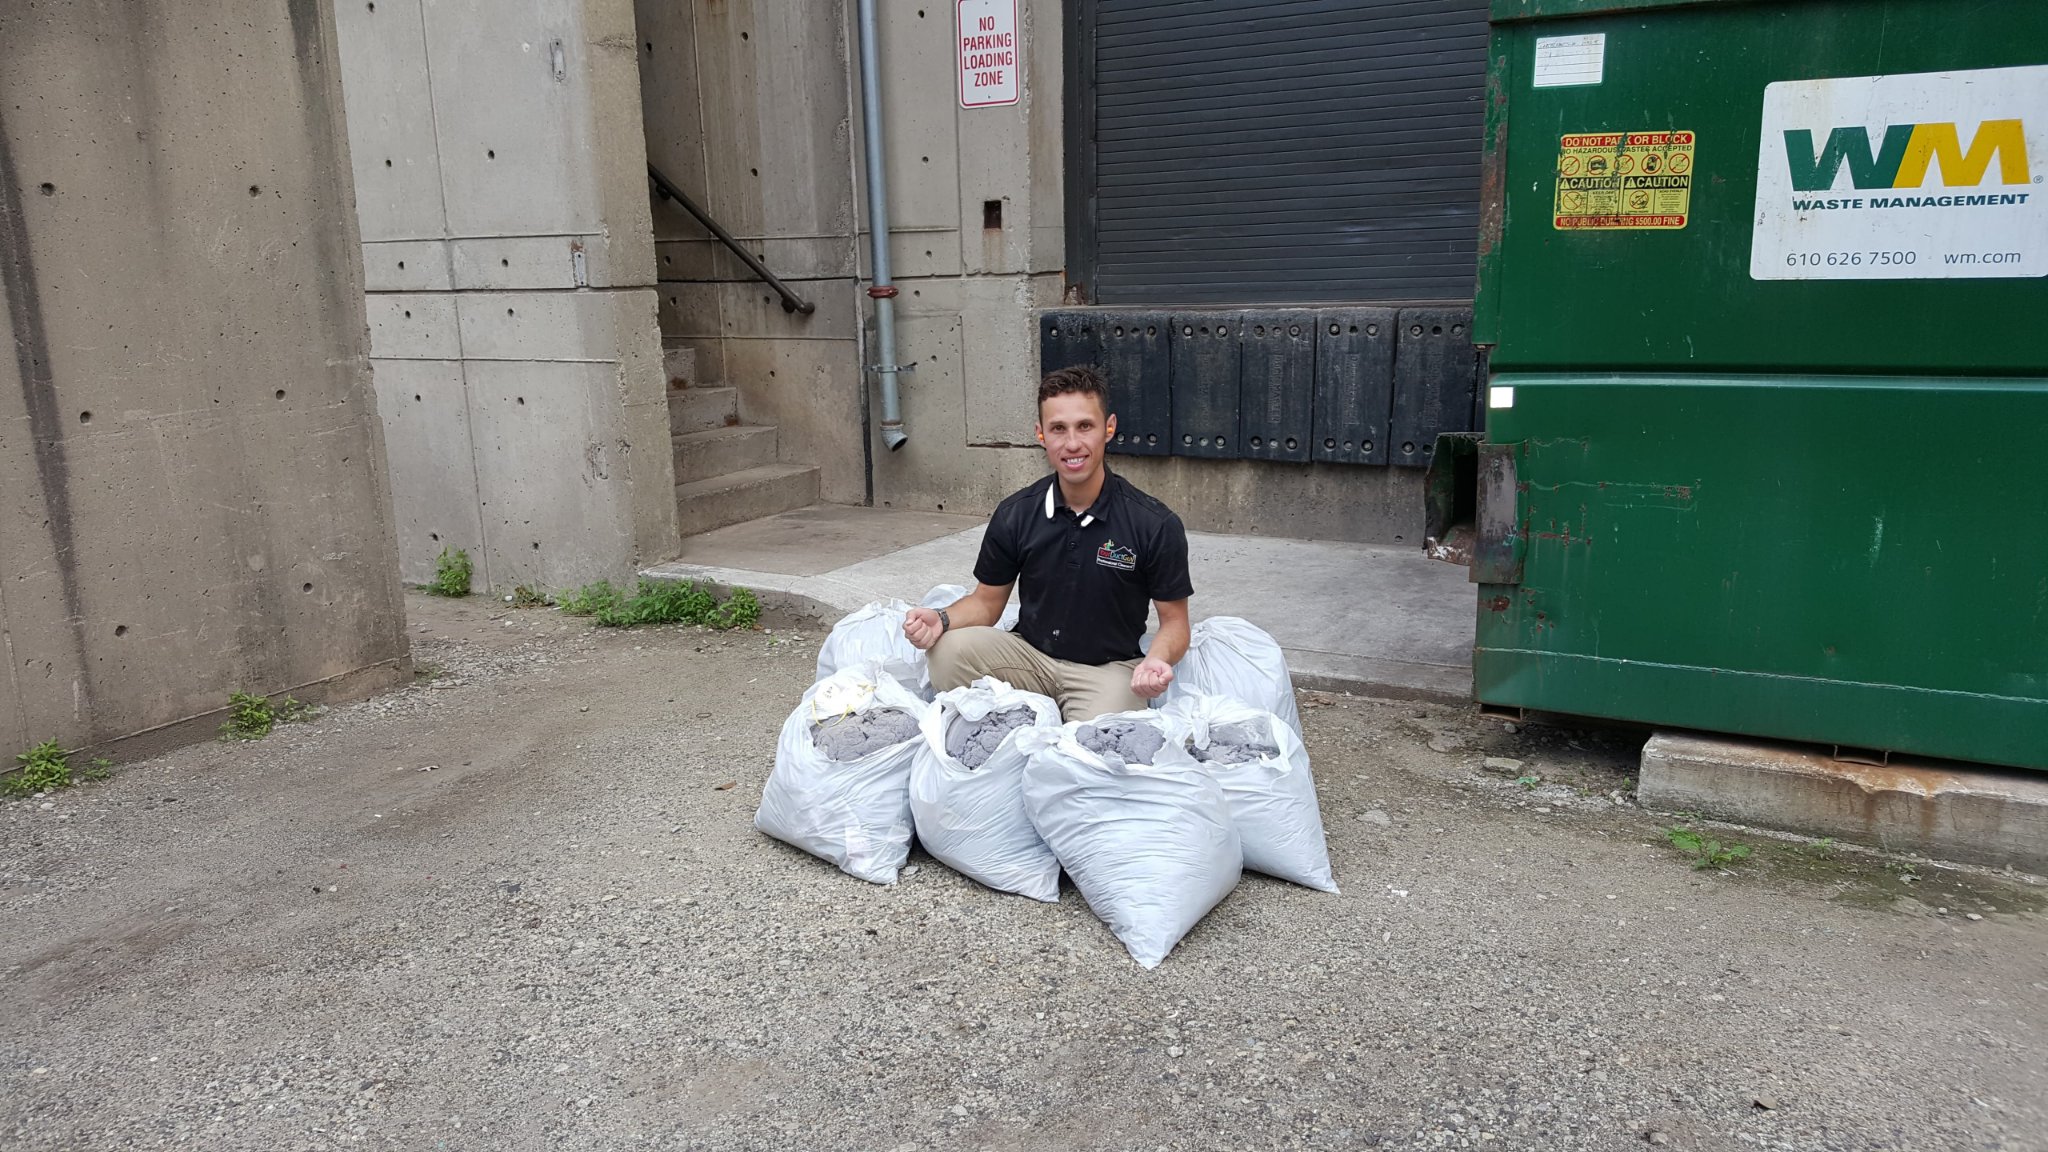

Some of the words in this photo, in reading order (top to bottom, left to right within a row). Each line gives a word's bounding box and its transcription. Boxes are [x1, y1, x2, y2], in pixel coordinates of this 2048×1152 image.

[979, 16, 995, 31] NO
[963, 33, 1012, 51] PARKING
[964, 51, 1013, 69] LOADING
[974, 70, 1003, 87] ZONE
[1565, 138, 1580, 147] DO
[1582, 137, 1602, 146] NOT
[1605, 136, 1632, 146] PAK
[1634, 135, 1650, 145] OR
[1652, 134, 1688, 144] BLOCK
[1783, 119, 2031, 191] WM
[1636, 176, 1688, 188] CAUTION
[1793, 198, 1864, 211] WASTE
[1869, 194, 2030, 208] MANAGEMENT
[1663, 216, 1681, 225] FINE
[1786, 253, 1821, 266] 610
[1827, 252, 1862, 266] 626
[1869, 251, 1917, 265] 7500
[1944, 252, 2021, 264] wm.com
